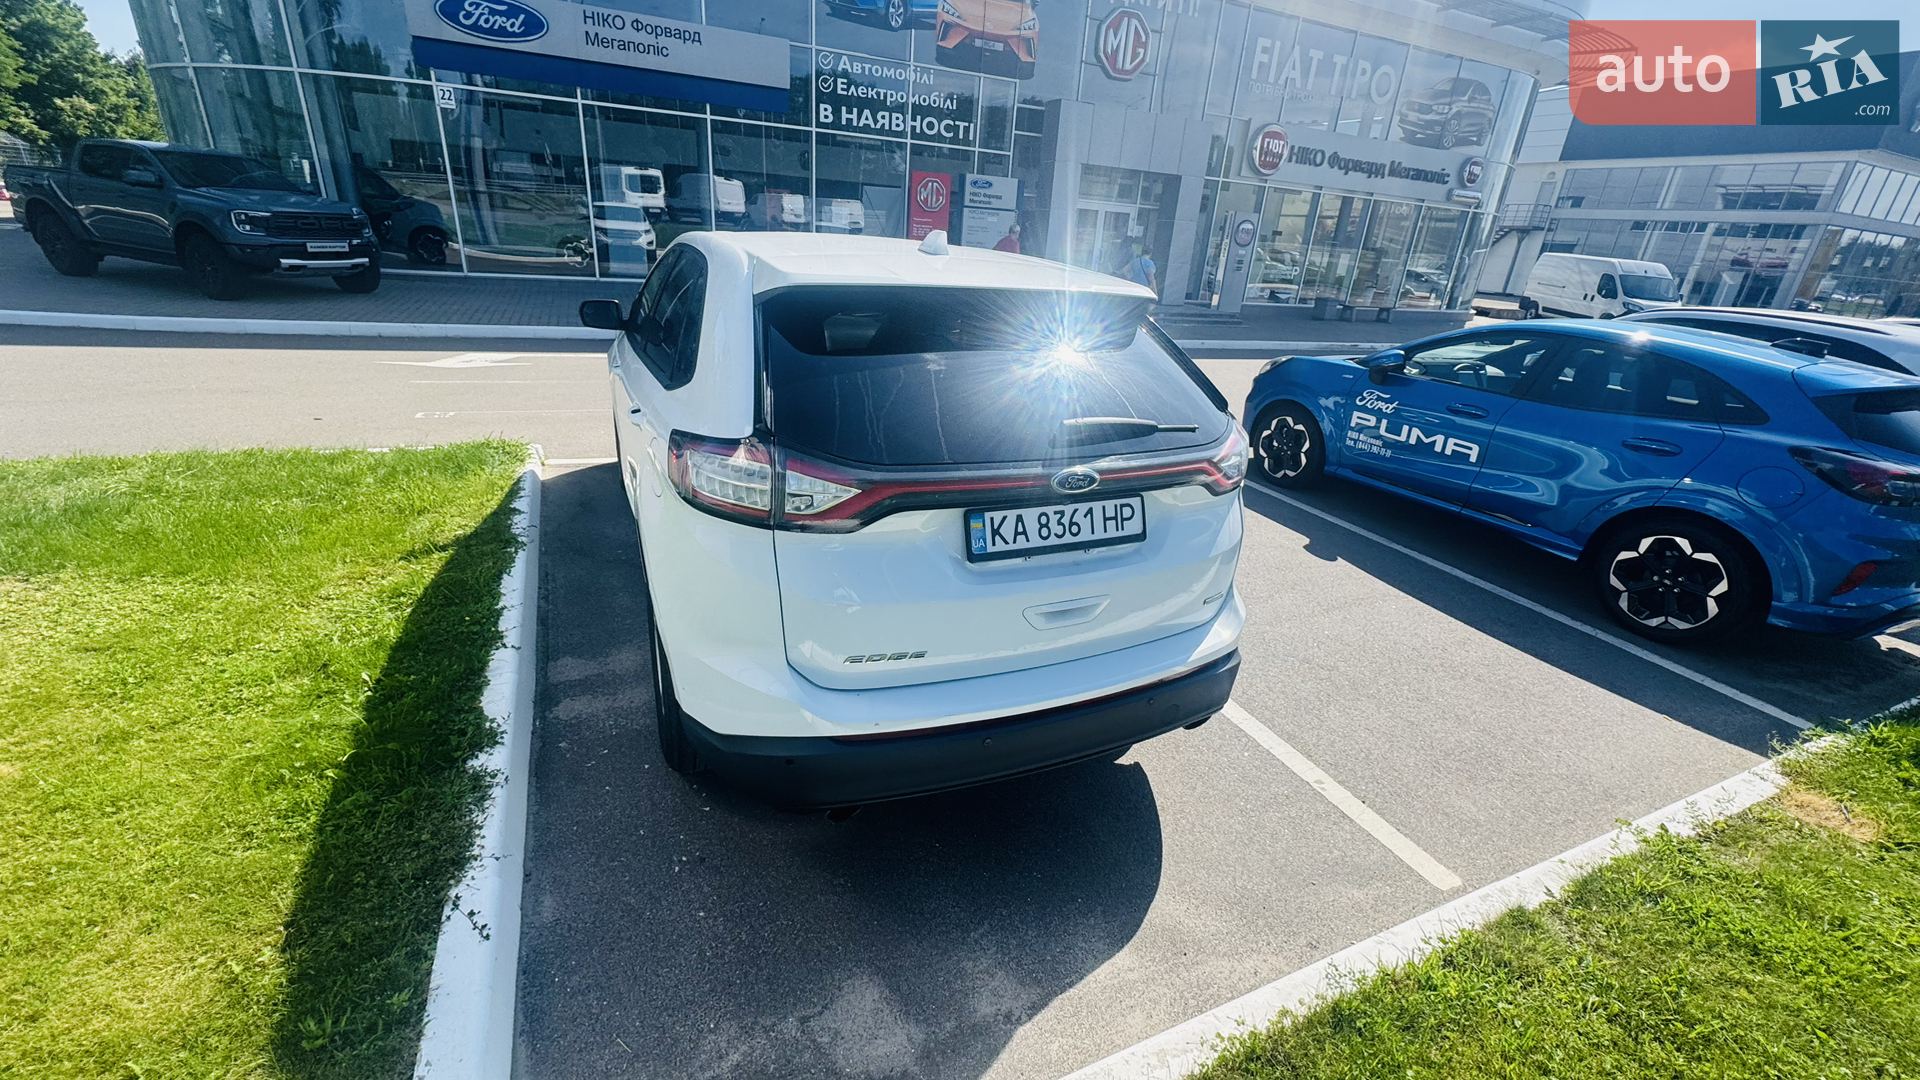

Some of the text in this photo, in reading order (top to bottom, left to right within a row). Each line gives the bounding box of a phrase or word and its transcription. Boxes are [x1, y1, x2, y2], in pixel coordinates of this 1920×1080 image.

[459, 0, 526, 33] Ford
[583, 9, 702, 46] НІКО Форвард
[585, 30, 670, 58] Мегаполіс
[1105, 16, 1146, 71] MG
[837, 54, 935, 86] Автомобілі
[1250, 36, 1325, 91] FIAT
[439, 88, 453, 101] 22
[837, 77, 958, 110] Електромобілі
[819, 103, 975, 140] В НАЯВНОСТІ
[1287, 144, 1451, 185] НІКО Форвард Мегаполіс
[920, 181, 943, 208] MG
[1355, 389, 1399, 414] Ford
[1350, 410, 1480, 463] PUMA
[990, 502, 1136, 547] KA 8361 HP
[972, 537, 986, 549] UA
[843, 650, 928, 664] EDGE
